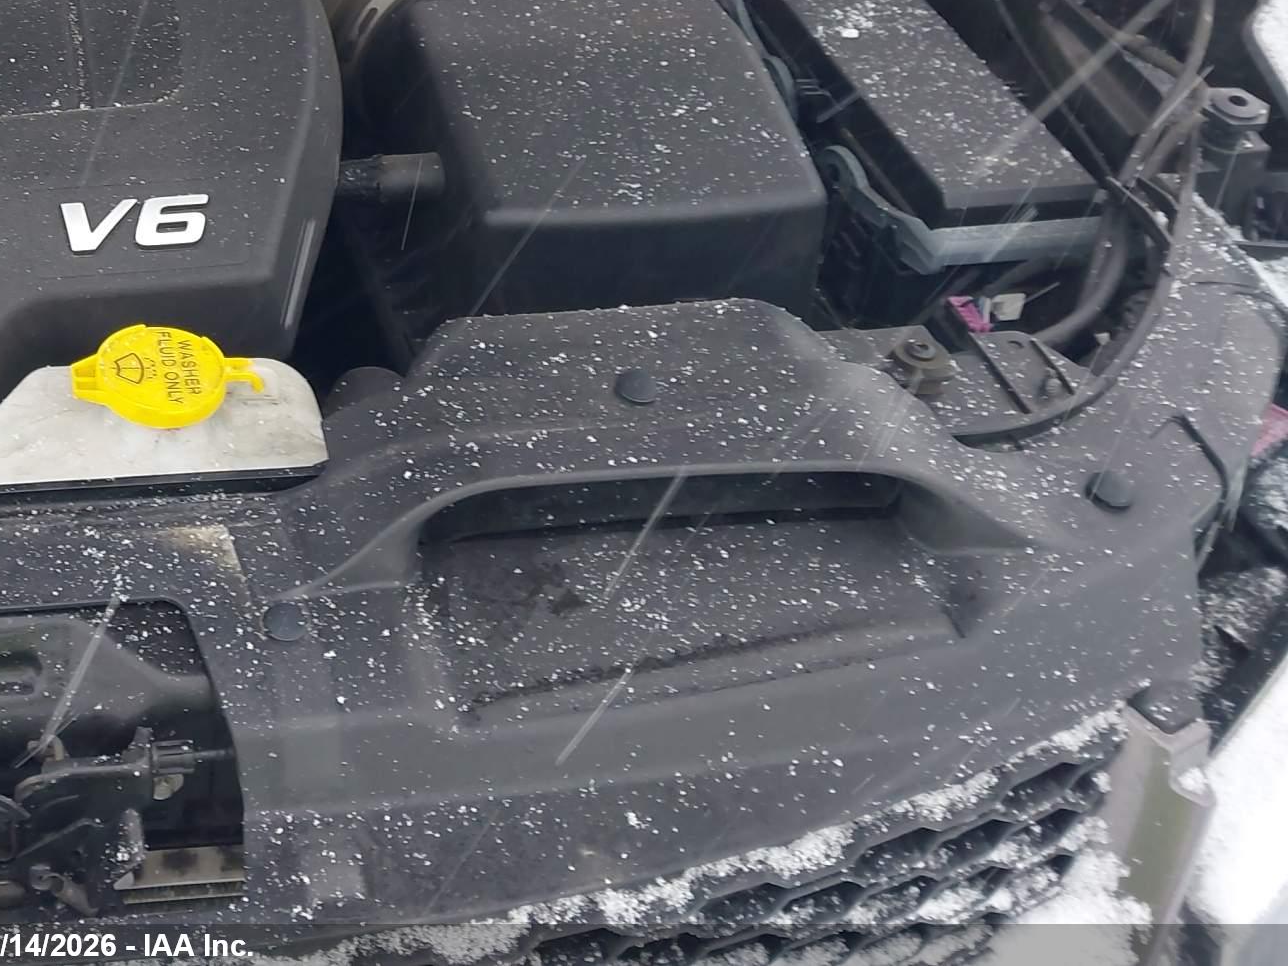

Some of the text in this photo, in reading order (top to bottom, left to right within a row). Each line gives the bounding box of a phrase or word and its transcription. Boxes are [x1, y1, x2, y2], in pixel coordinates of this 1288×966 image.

[61, 194, 209, 255] V6
[155, 331, 184, 404] FLUID ONLY
[177, 339, 202, 395] WASHER
